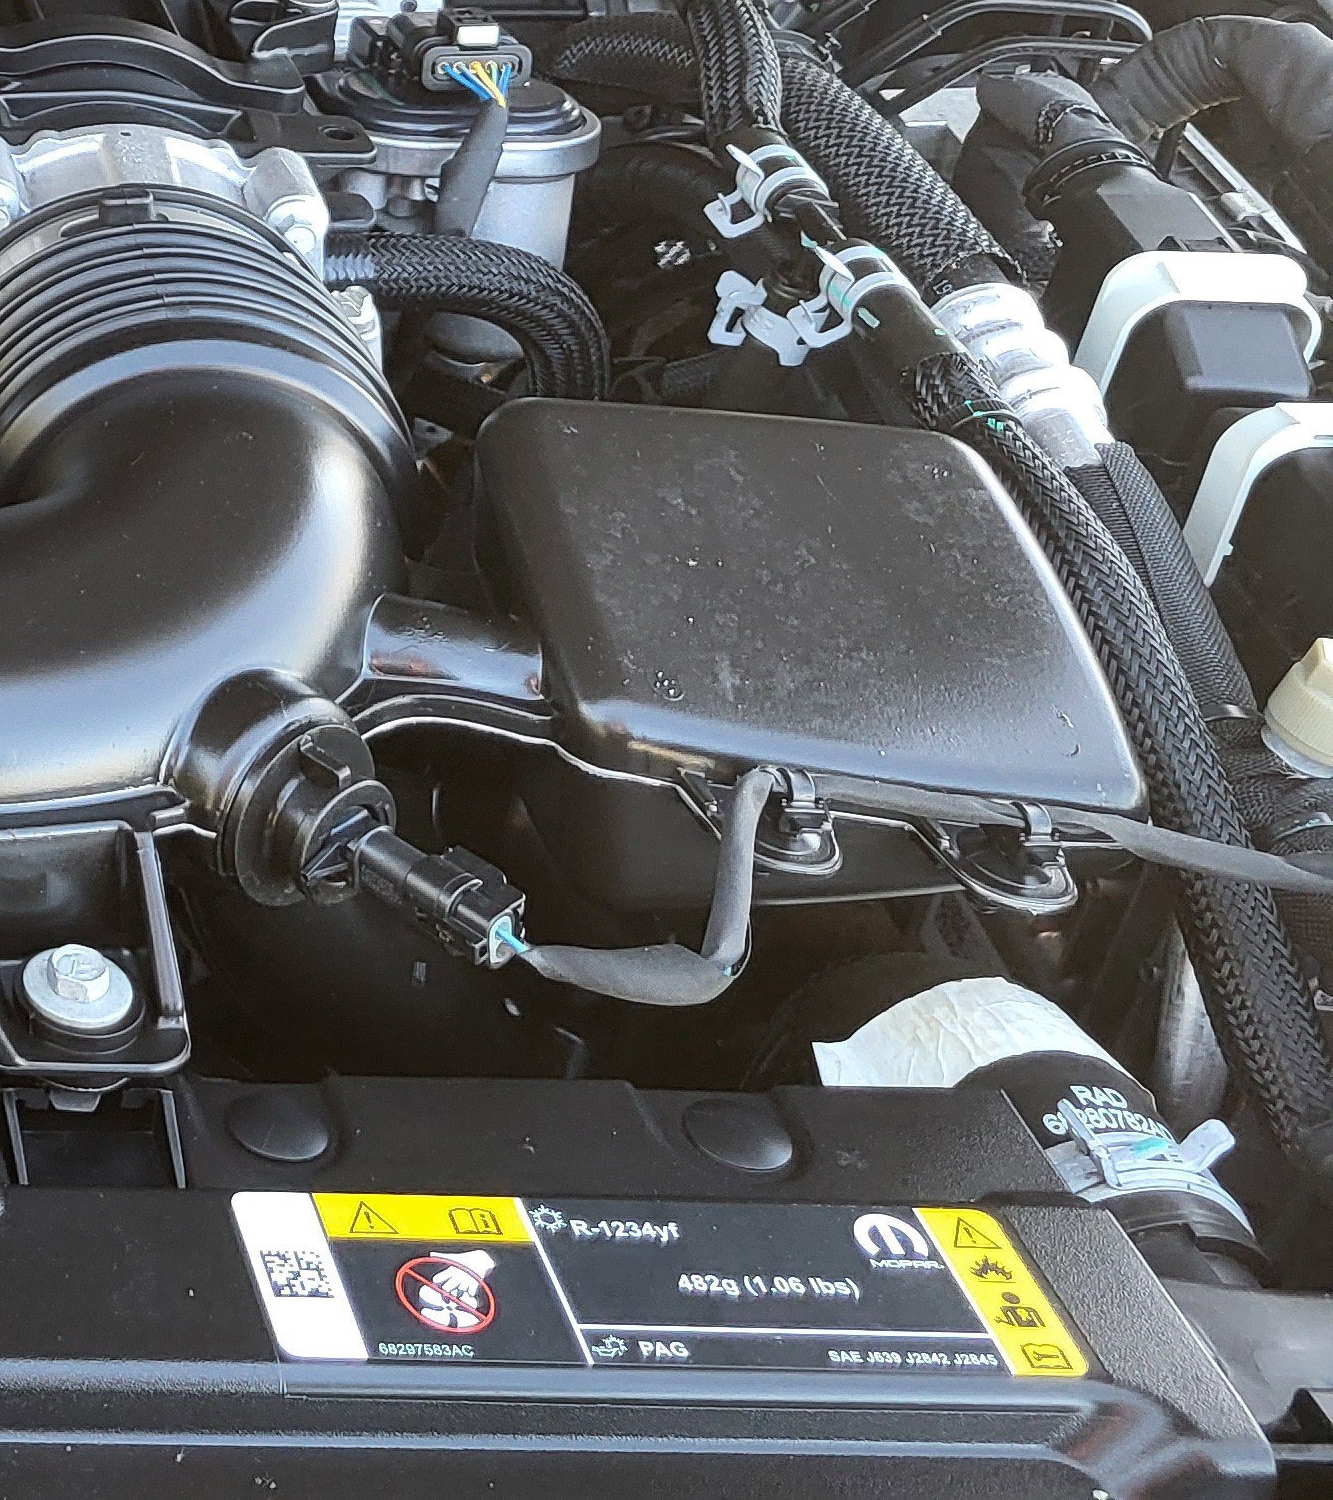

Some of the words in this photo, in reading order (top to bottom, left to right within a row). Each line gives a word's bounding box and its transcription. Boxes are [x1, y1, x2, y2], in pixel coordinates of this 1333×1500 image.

[1069, 1085, 1128, 1109] RAD
[569, 1218, 680, 1242] R-1234yf
[677, 1273, 738, 1297] 482g
[742, 1275, 808, 1299] (1.06
[813, 1277, 861, 1300] lbs)
[639, 1340, 689, 1360] PAG
[828, 1350, 864, 1364] SAE
[866, 1351, 902, 1366] J639
[905, 1352, 951, 1366] J2842
[953, 1353, 998, 1367] J2845
